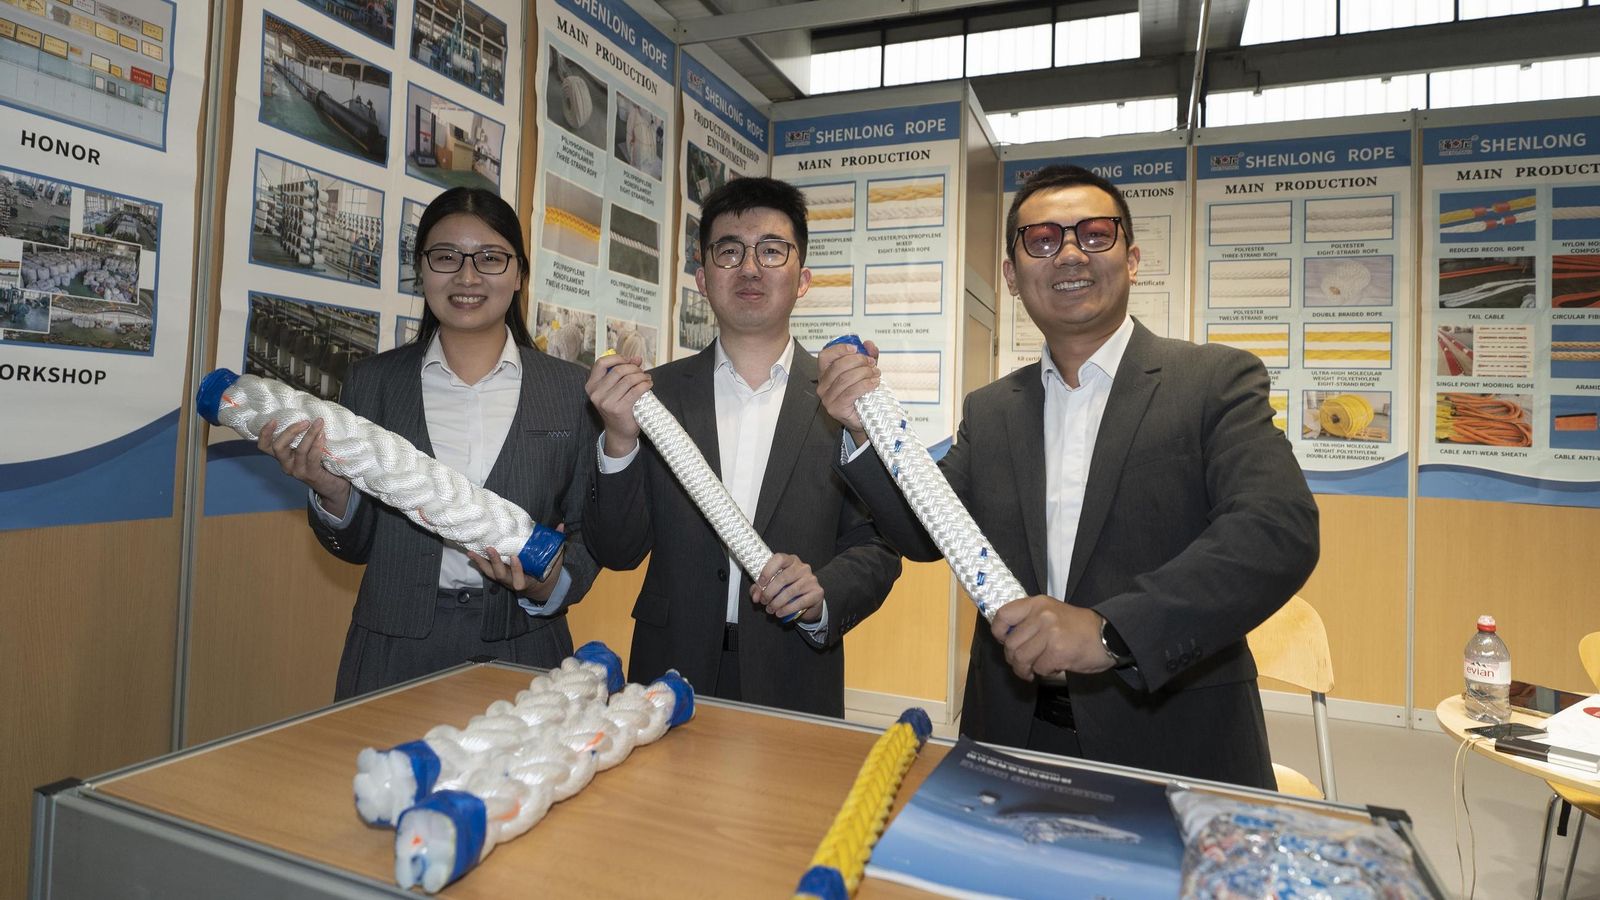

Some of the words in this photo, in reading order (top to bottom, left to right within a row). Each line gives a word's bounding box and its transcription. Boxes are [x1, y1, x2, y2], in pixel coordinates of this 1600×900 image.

[556, 15, 589, 49] MAIN
[595, 42, 658, 96] PRODUCTION
[642, 37, 668, 70] ROPE
[704, 86, 744, 126] SHENLONG
[746, 118, 764, 142] ROPE
[693, 109, 731, 144] PRODUCTION
[731, 137, 760, 164] WORKSHOP
[815, 123, 894, 144] SHENLONG
[905, 118, 947, 135] ROPE
[20, 129, 101, 165] HONOR
[706, 135, 747, 170] ENVIRONMENT
[1480, 132, 1588, 154] SHENLONG
[797, 158, 832, 172] MAIN
[841, 149, 931, 168] PRODUCTION
[1133, 161, 1174, 176] ROPE
[1245, 150, 1336, 169] SHENLONG
[1348, 146, 1395, 162] ROPE
[1456, 168, 1503, 181] MAIN
[1515, 163, 1600, 178] PRODUCT
[1121, 187, 1174, 199] ICATIONS
[1225, 183, 1265, 195] MAIN
[1275, 176, 1378, 192] PRODUCTION
[867, 232, 942, 242] POLYESTER/POLYPROPYLENE
[578, 287, 590, 297] ROPE
[0, 363, 107, 386] ORKSHOP
[1466, 665, 1495, 678] evian
